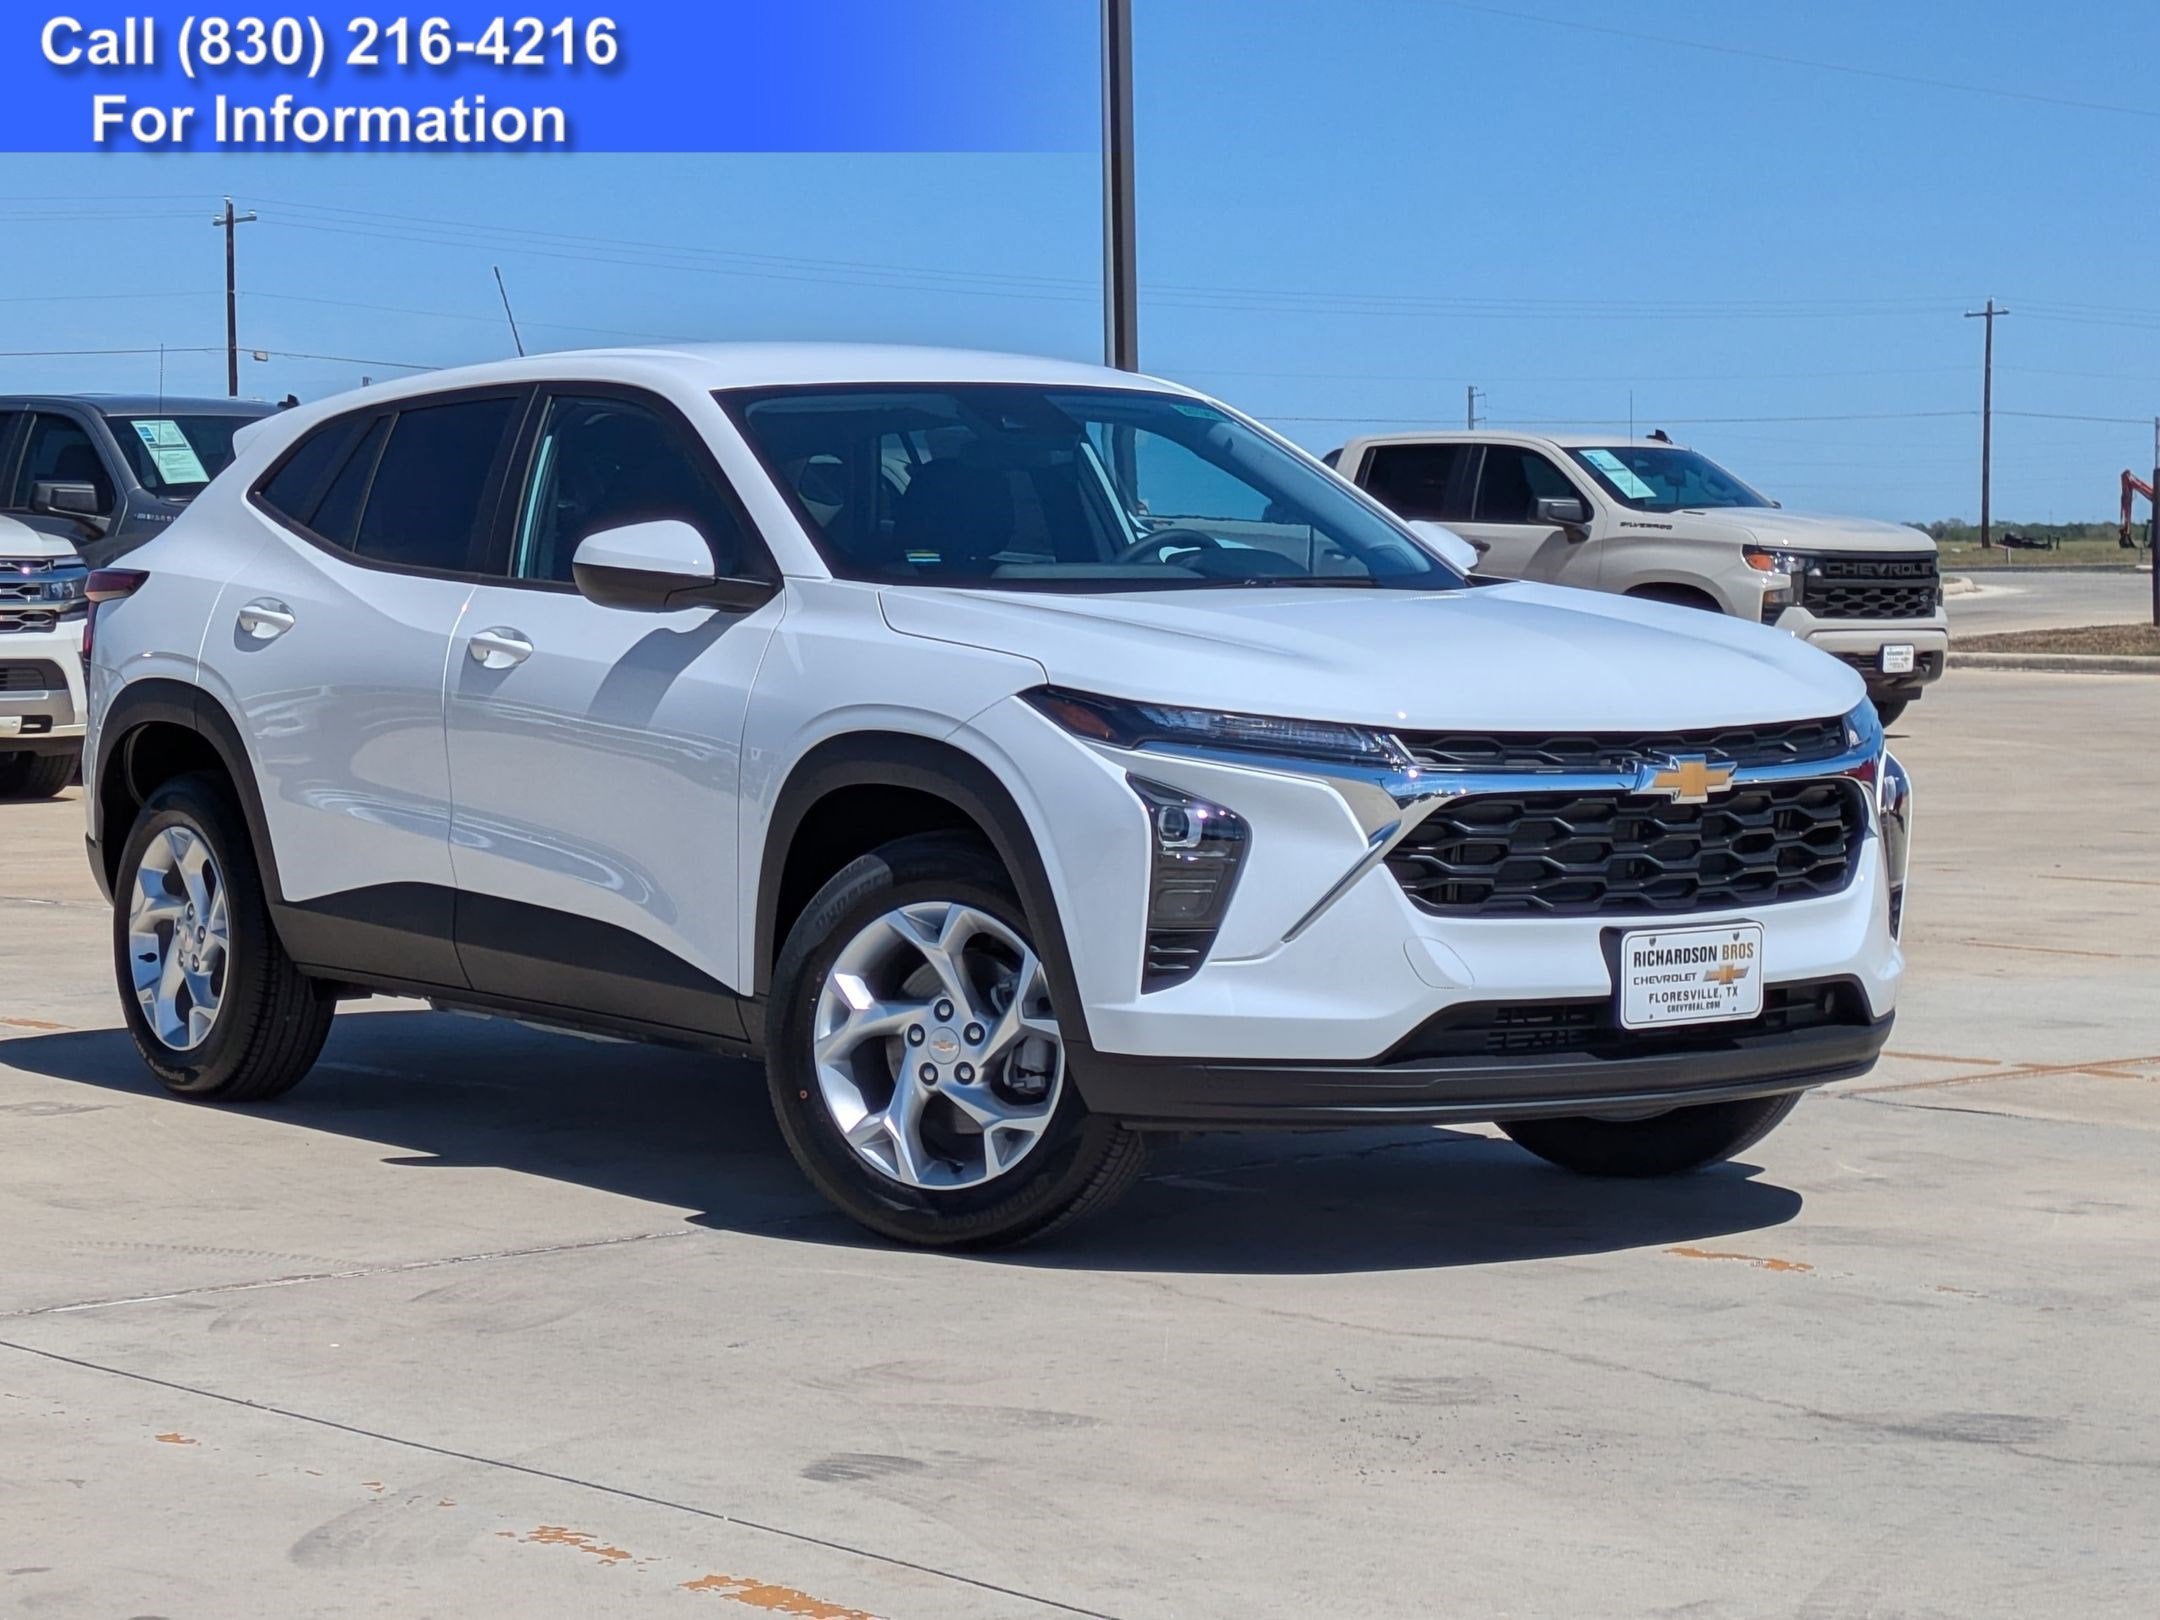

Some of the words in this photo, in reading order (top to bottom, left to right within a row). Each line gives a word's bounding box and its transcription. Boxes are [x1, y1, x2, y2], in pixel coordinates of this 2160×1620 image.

[1633, 945, 1718, 968] RICHARDSON
[1721, 942, 1754, 961] BROS
[1633, 972, 1698, 986] CHEVROLET
[1648, 990, 1722, 1004] FLORESVILLE,
[1726, 985, 1738, 997] TX
